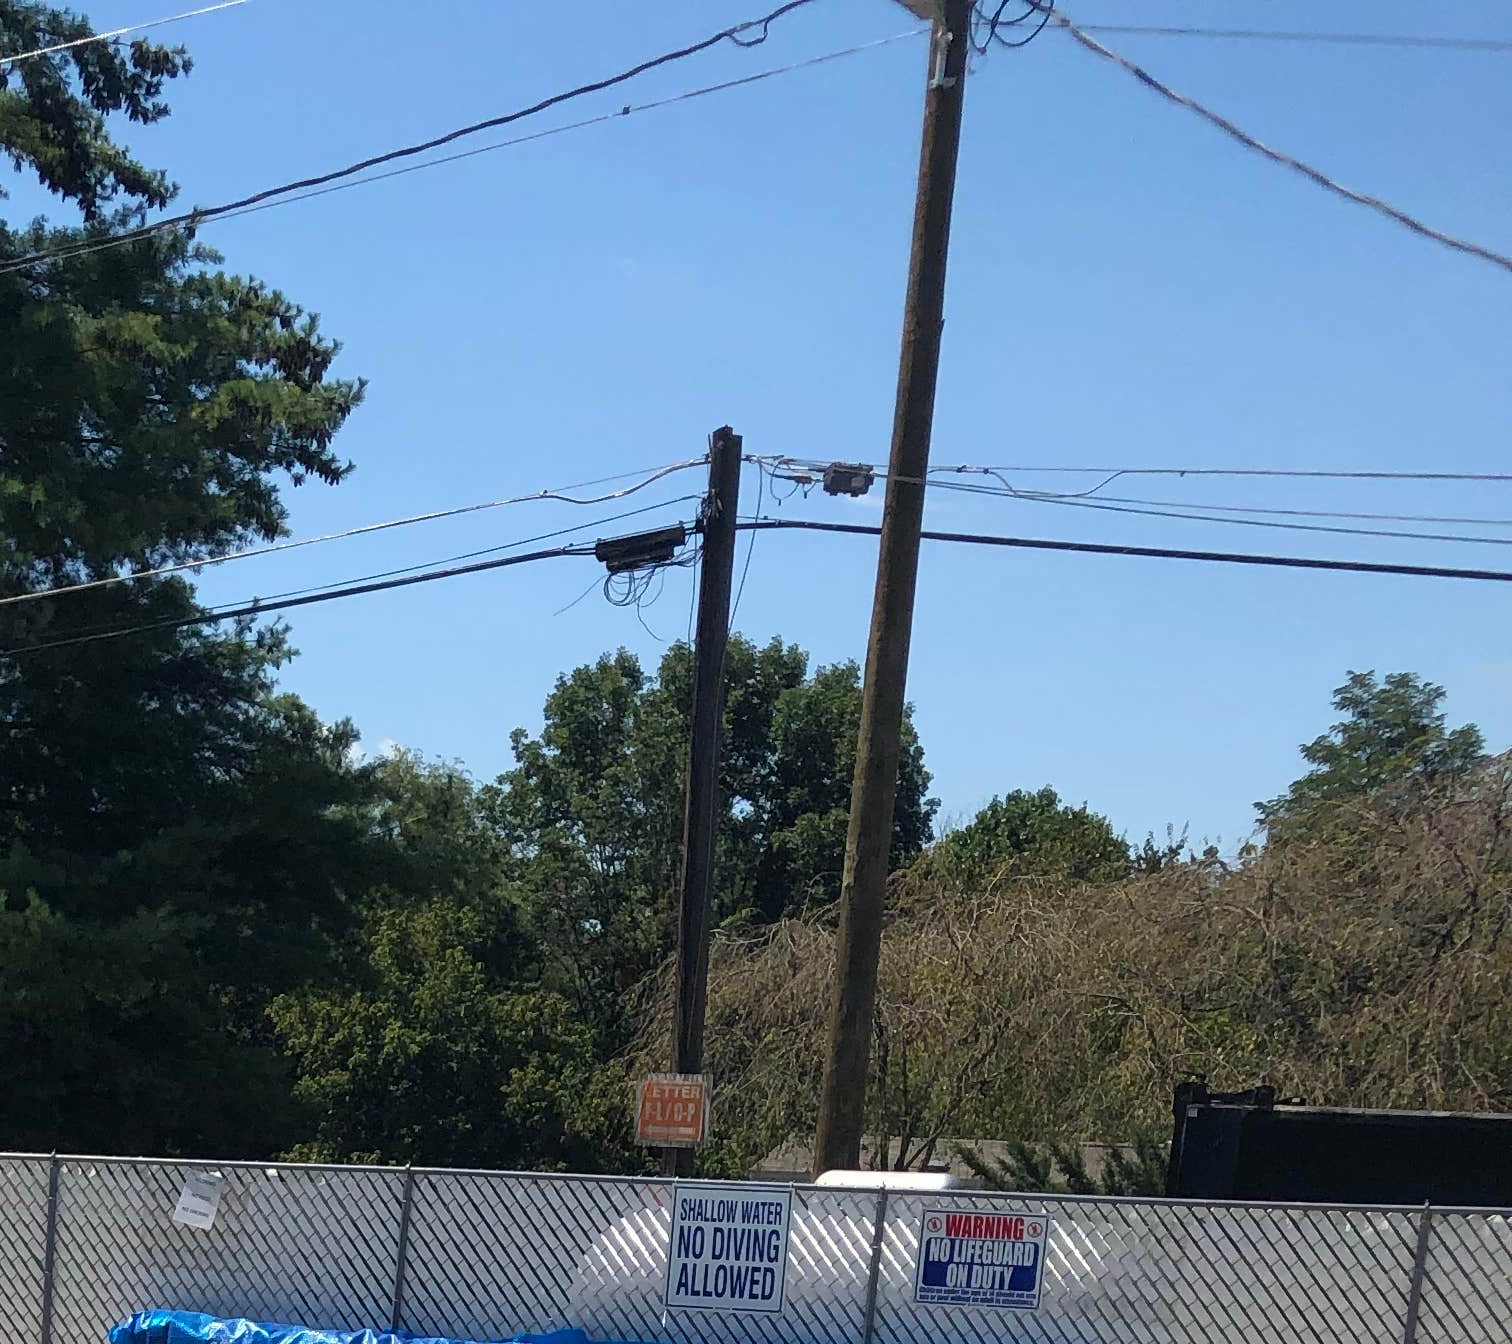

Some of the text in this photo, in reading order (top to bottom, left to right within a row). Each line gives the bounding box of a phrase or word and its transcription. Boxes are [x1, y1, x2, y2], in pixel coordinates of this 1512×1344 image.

[680, 1198, 783, 1225] SHALLOW WATER
[945, 1214, 1025, 1240] WARNING
[677, 1225, 781, 1263] NO DIVING
[928, 1238, 1035, 1267] NO LIFEGUARD
[675, 1263, 776, 1300] ALLOWED
[945, 1264, 1014, 1290] ON DUTY
